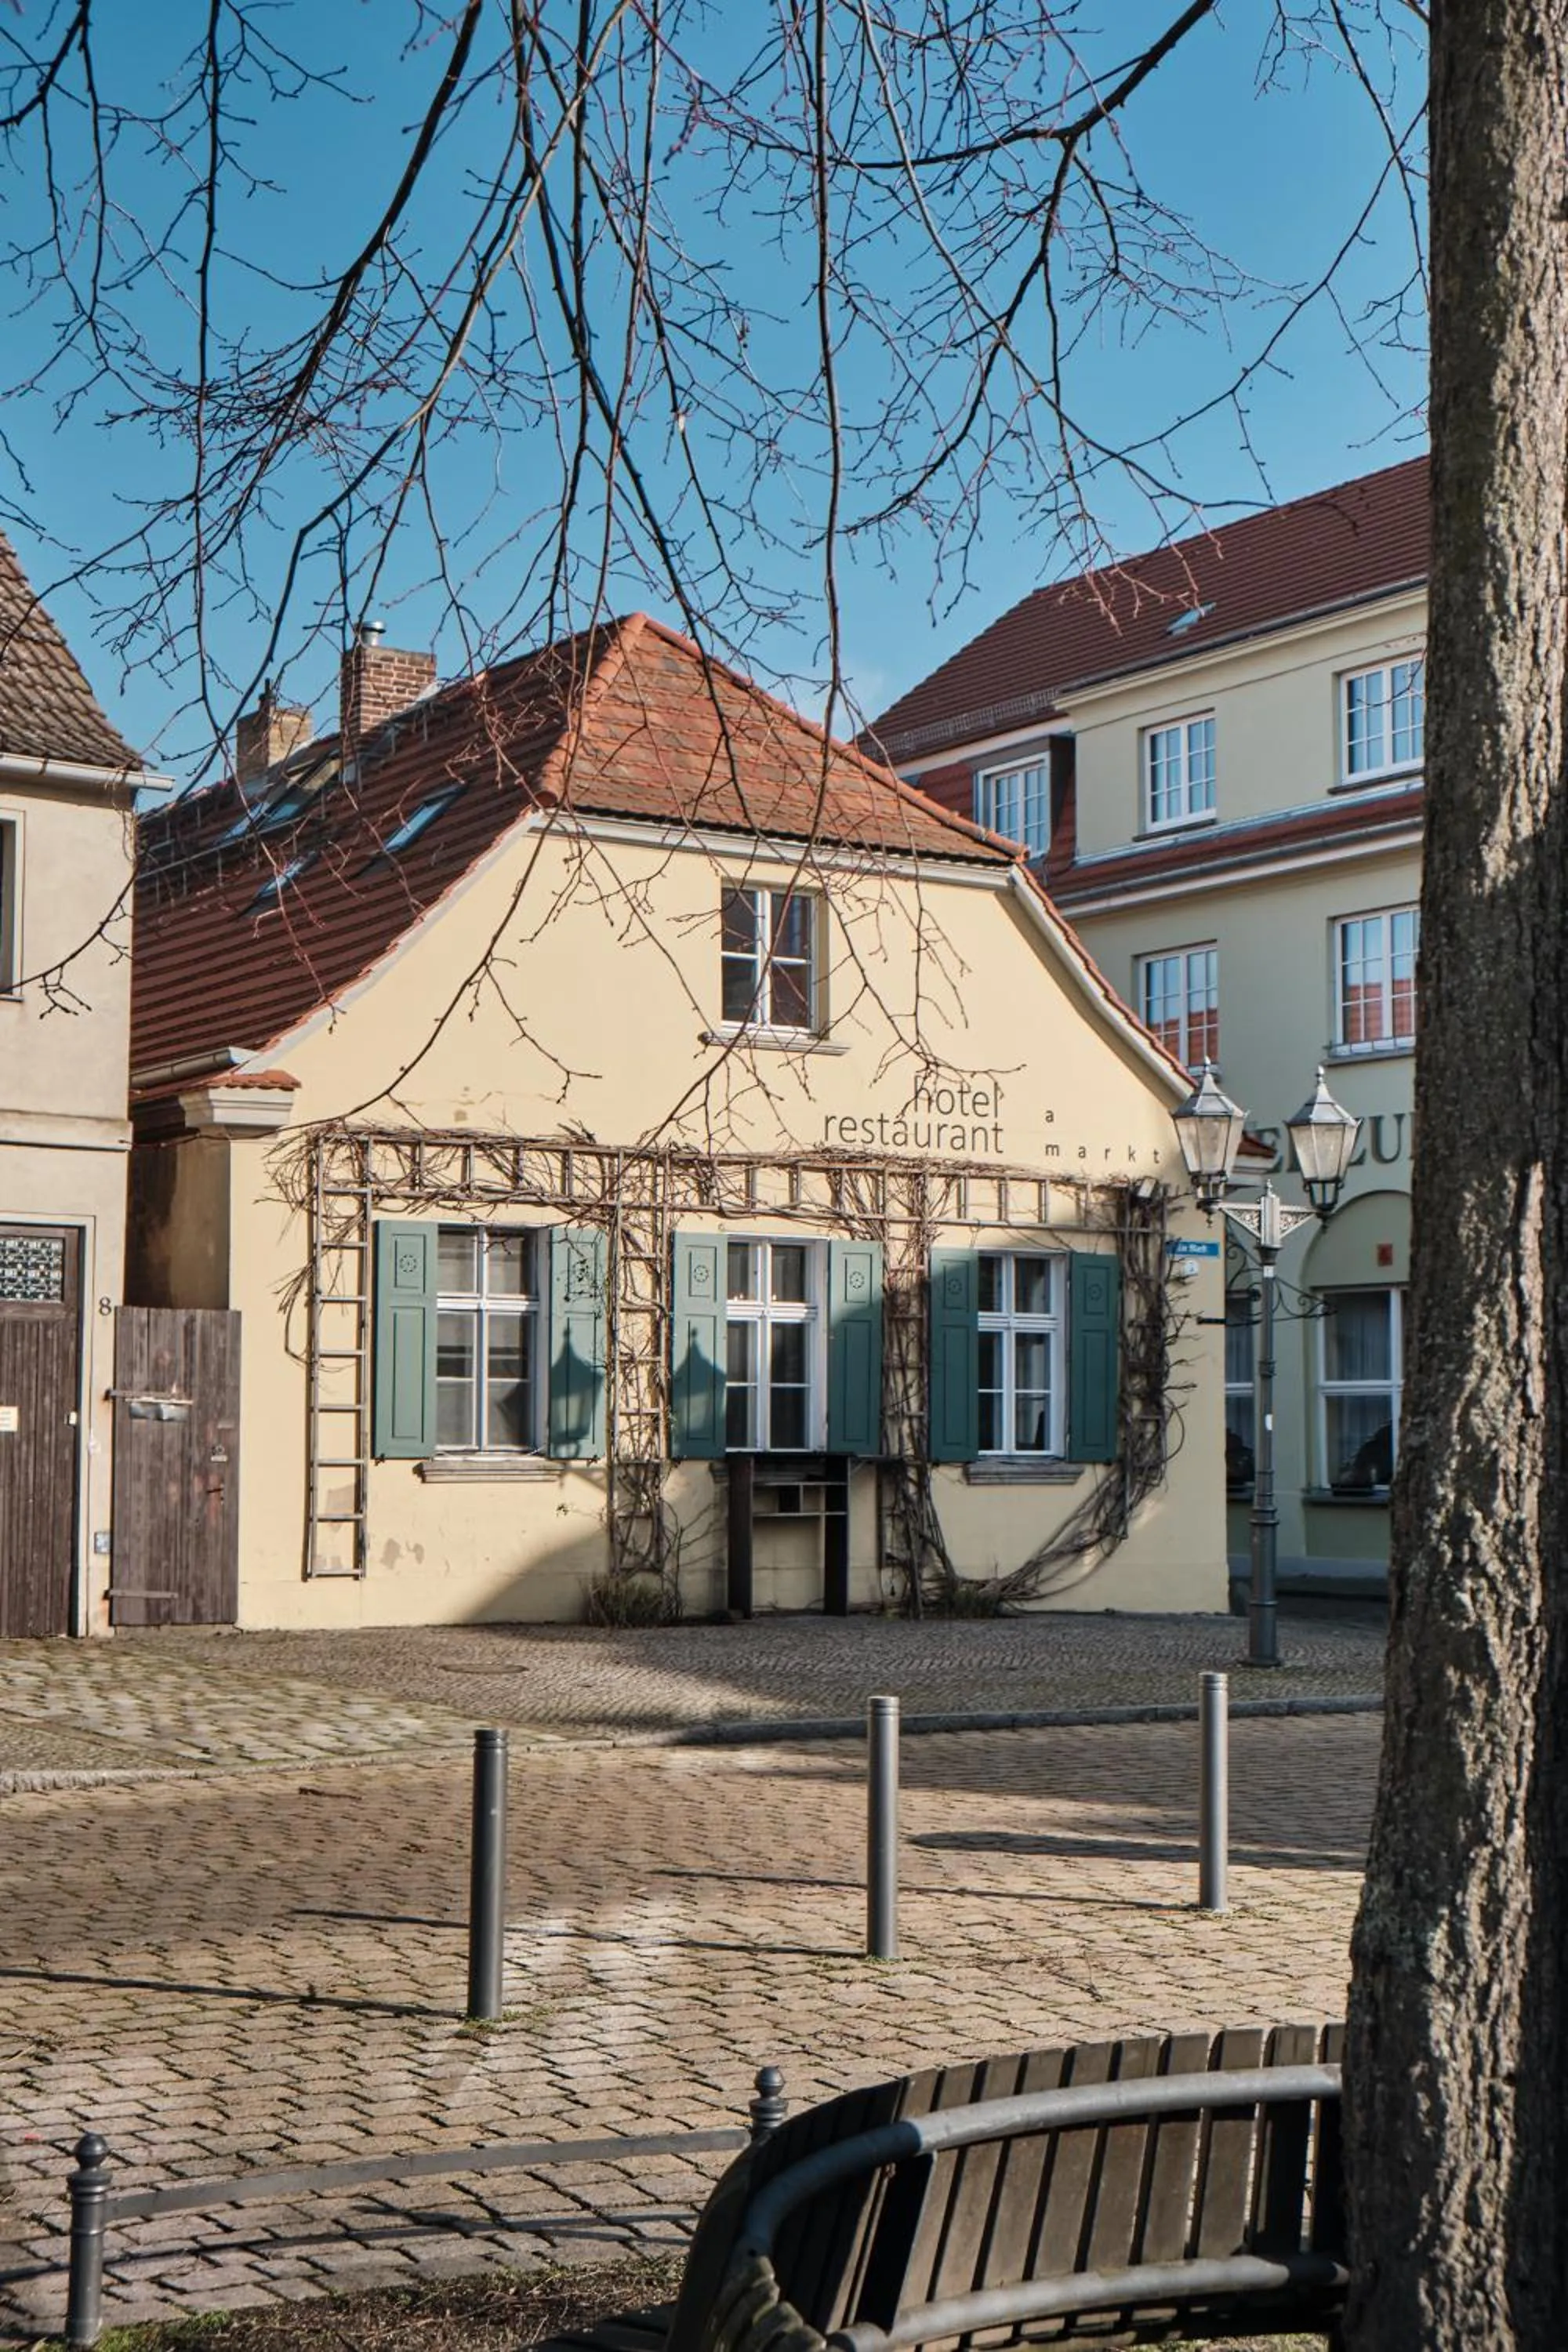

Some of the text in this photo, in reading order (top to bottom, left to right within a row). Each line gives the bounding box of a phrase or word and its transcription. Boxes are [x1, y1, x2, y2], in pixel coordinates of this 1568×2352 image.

[914, 1075, 999, 1119] hotel
[824, 1113, 1004, 1154] restaurant
[99, 1296, 112, 1316] 8
